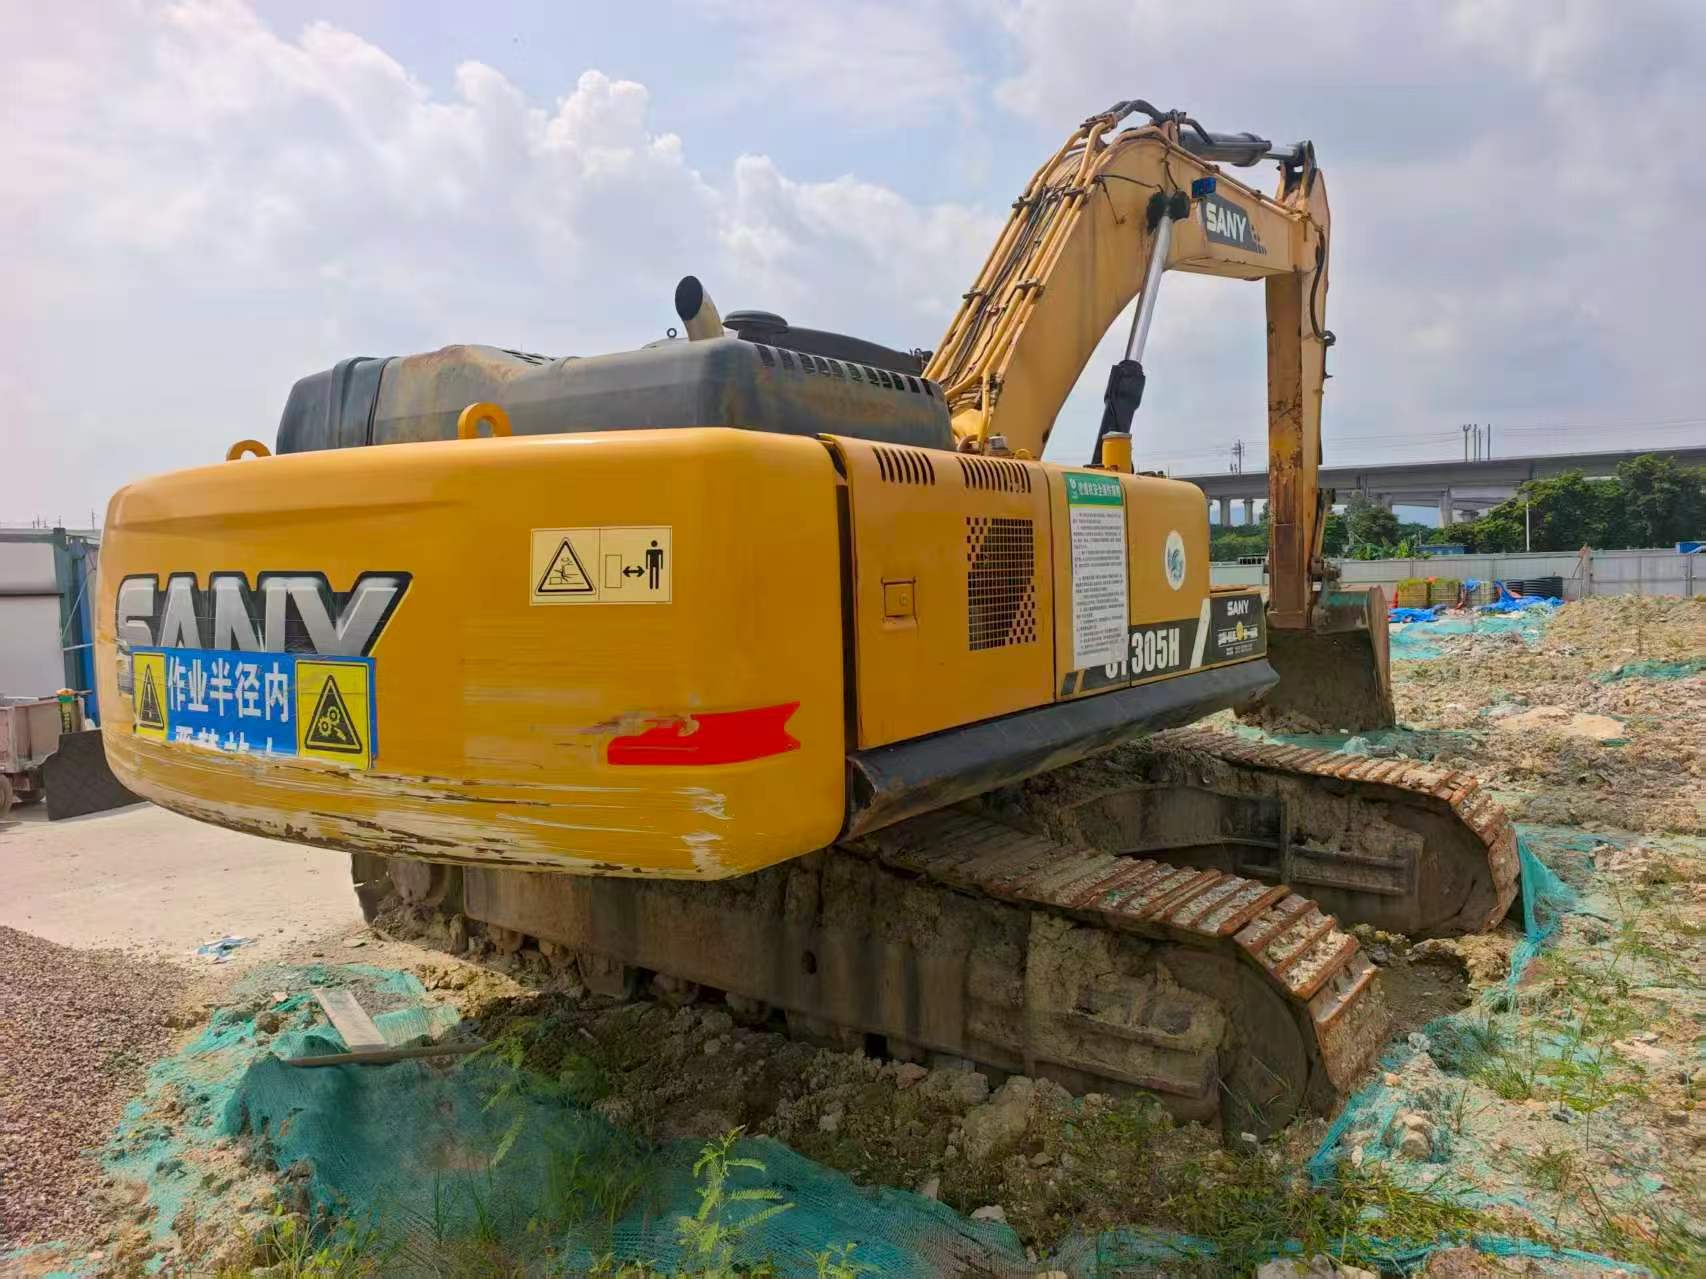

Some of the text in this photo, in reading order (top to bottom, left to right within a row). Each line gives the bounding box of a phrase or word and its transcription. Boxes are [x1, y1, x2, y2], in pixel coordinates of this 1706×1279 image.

[1206, 202, 1247, 243] SANY
[116, 571, 413, 680] SANY
[1227, 599, 1249, 616] SANY
[167, 656, 289, 722] 作业半径内
